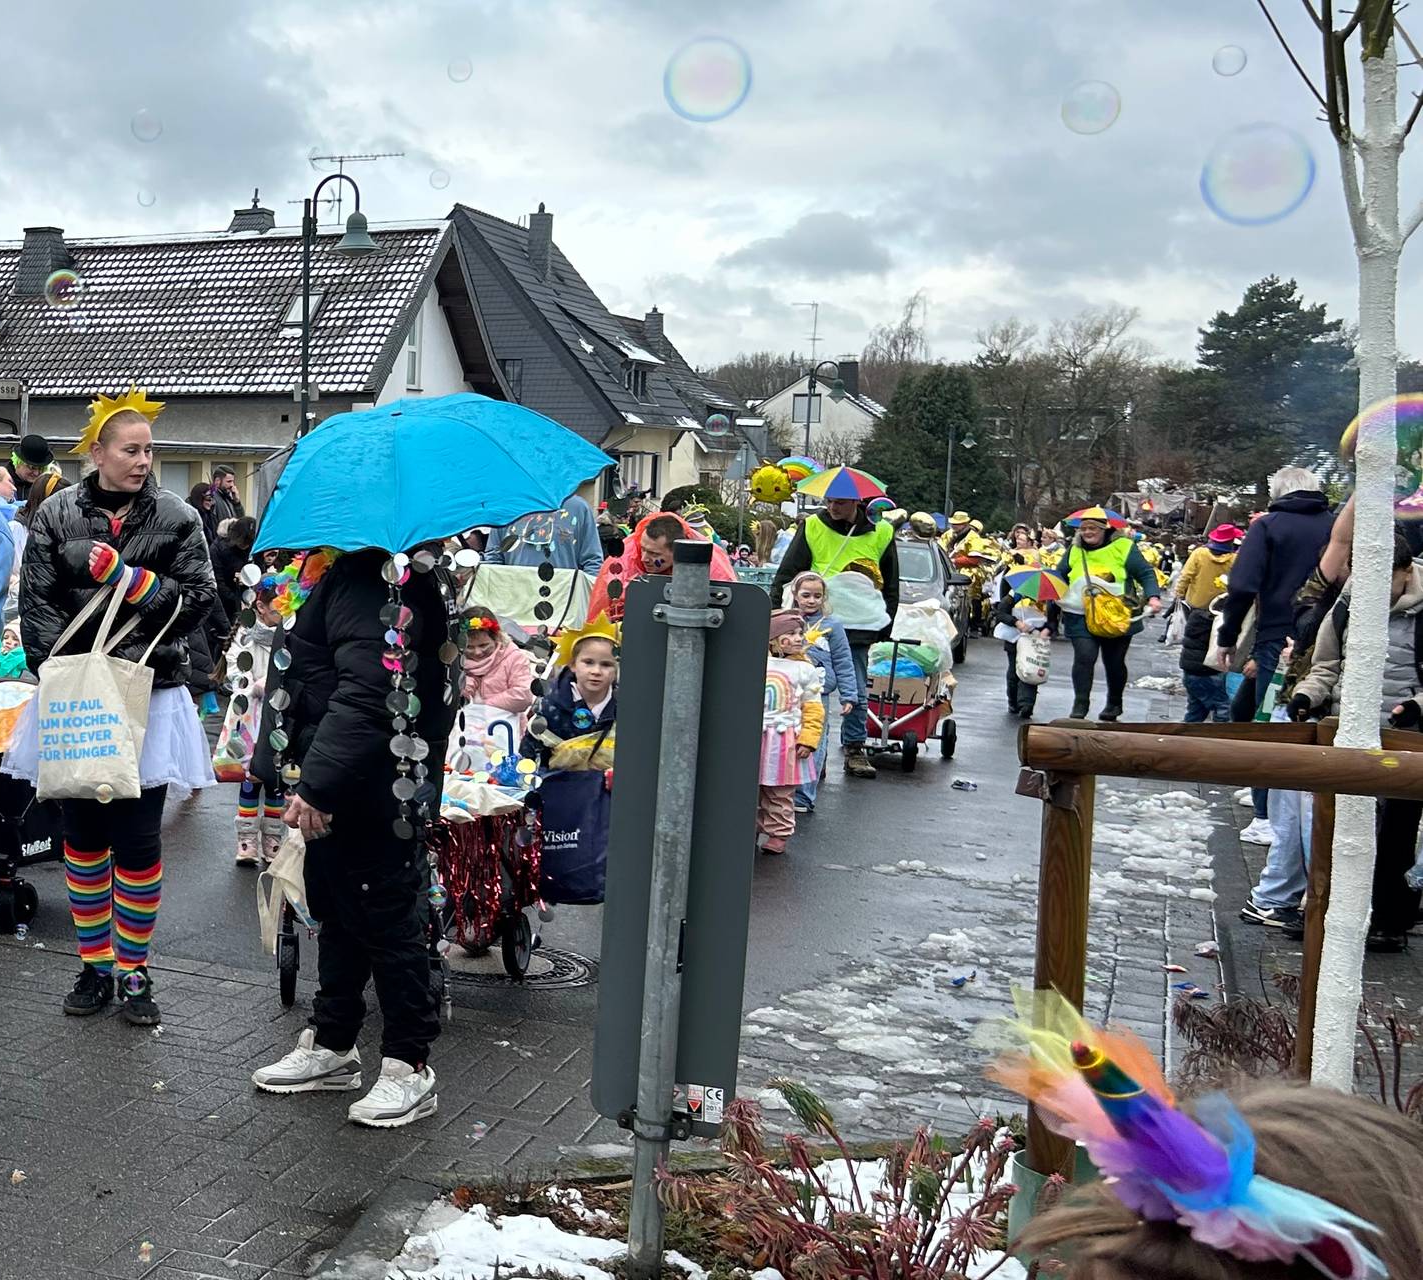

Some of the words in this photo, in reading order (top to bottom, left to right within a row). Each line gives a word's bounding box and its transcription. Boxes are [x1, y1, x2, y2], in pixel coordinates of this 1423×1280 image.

[49, 702, 67, 714] ZU
[70, 698, 103, 713] FAUL
[38, 718, 60, 730] UM
[43, 734, 59, 746] ZU
[61, 729, 112, 744] CLEVER
